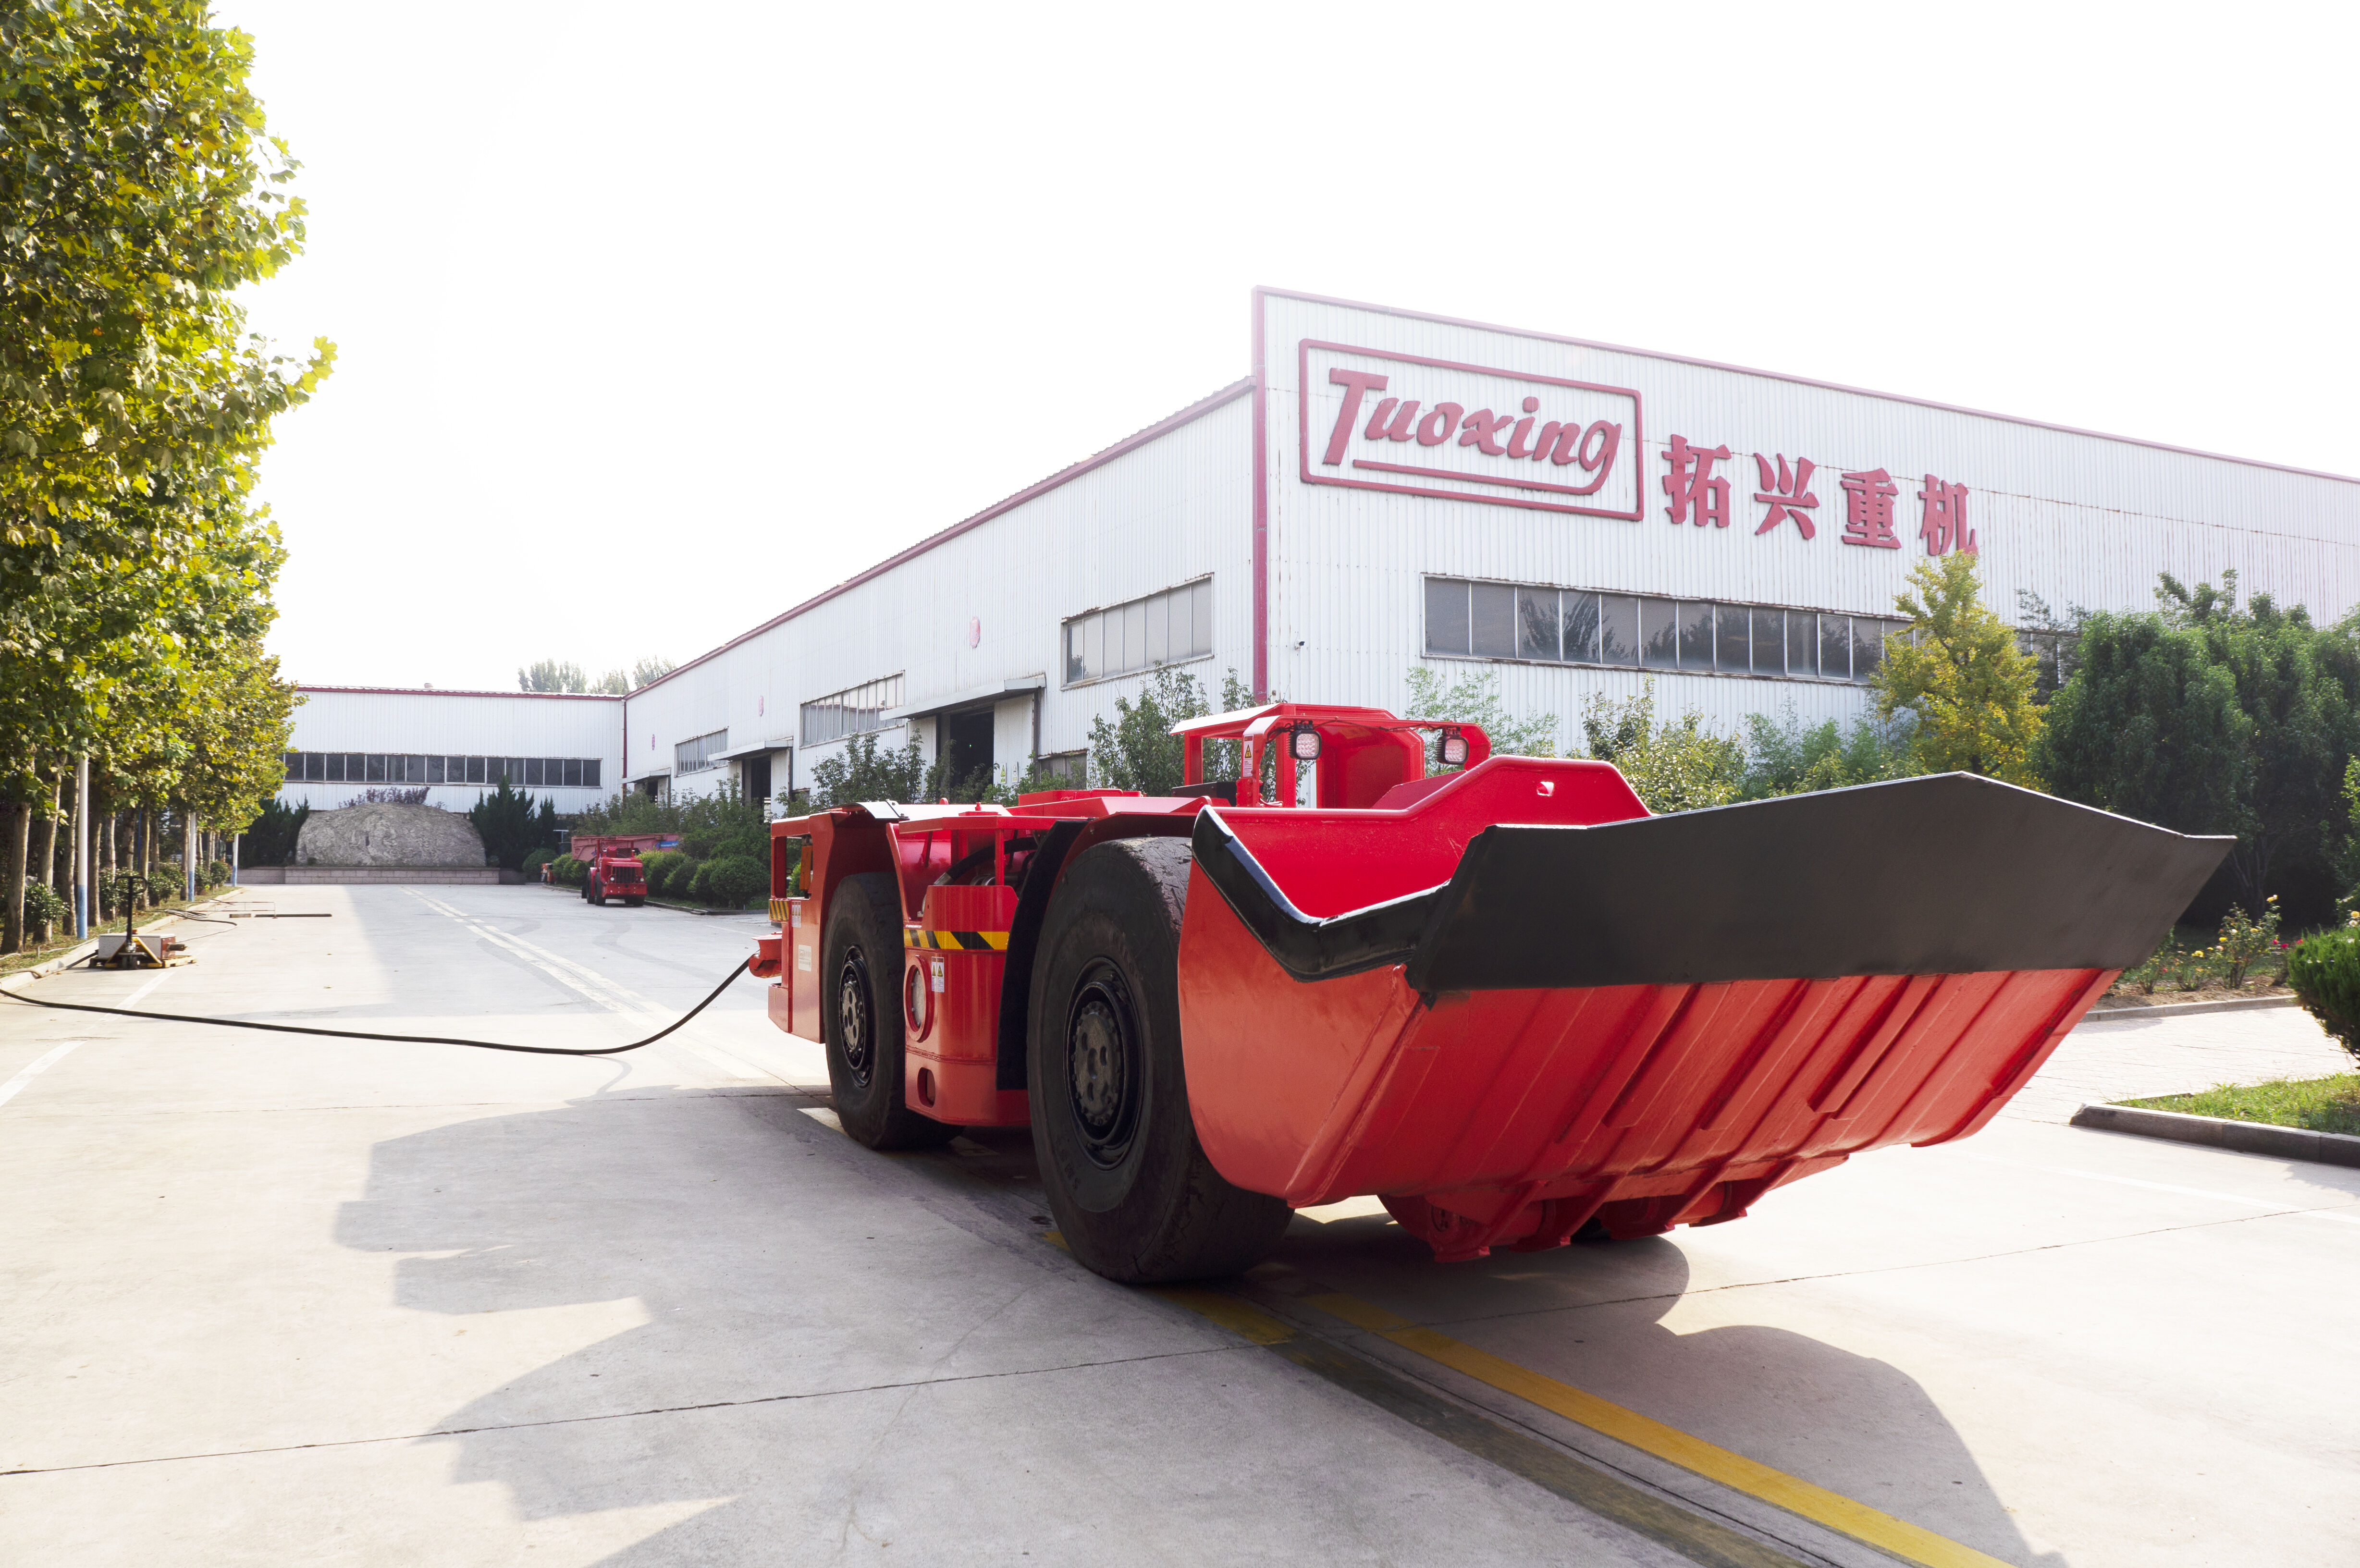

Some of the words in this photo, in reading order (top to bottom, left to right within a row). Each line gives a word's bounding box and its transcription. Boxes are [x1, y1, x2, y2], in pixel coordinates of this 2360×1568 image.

[1323, 367, 1622, 495] Tuoxing
[1661, 434, 1979, 557] 拓兴重机
